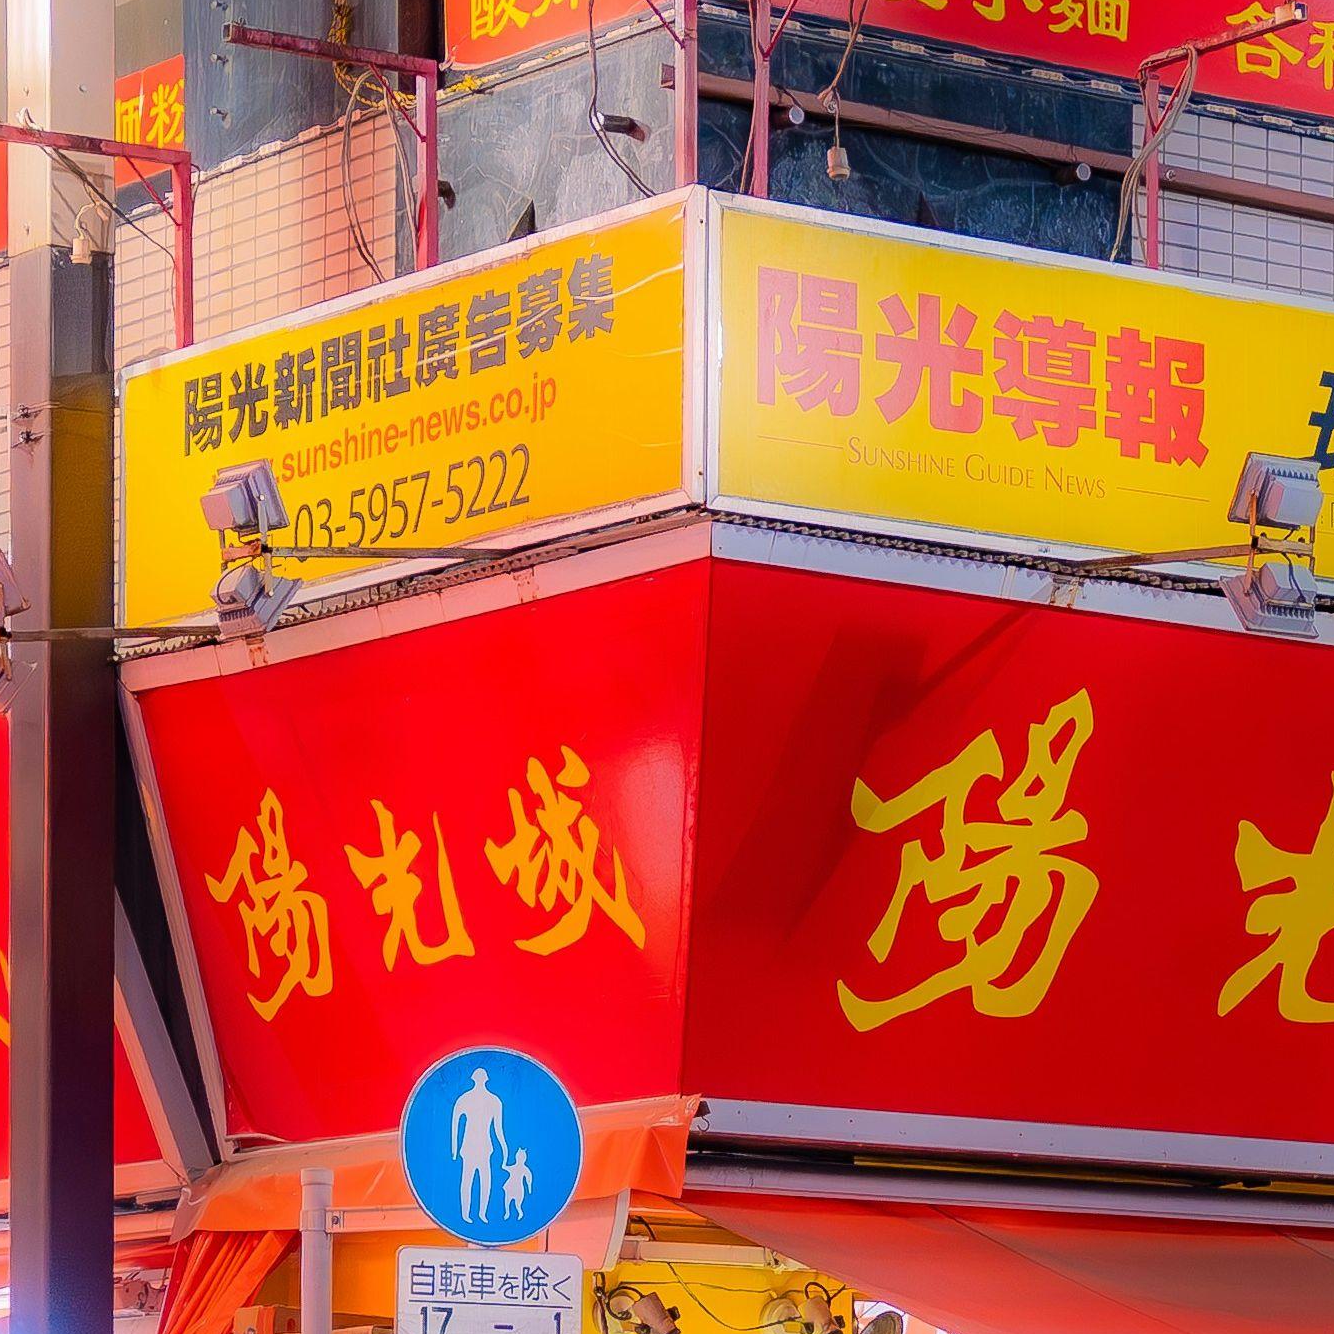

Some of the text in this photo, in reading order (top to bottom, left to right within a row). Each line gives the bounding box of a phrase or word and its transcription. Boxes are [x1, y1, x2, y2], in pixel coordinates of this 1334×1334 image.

[183, 252, 615, 457] 陽光新聞社廣告募集
[757, 266, 1209, 468] 陽光導報
[203, 744, 647, 1022] 陽光城
[408, 1260, 572, 1301] 自転車を除く
